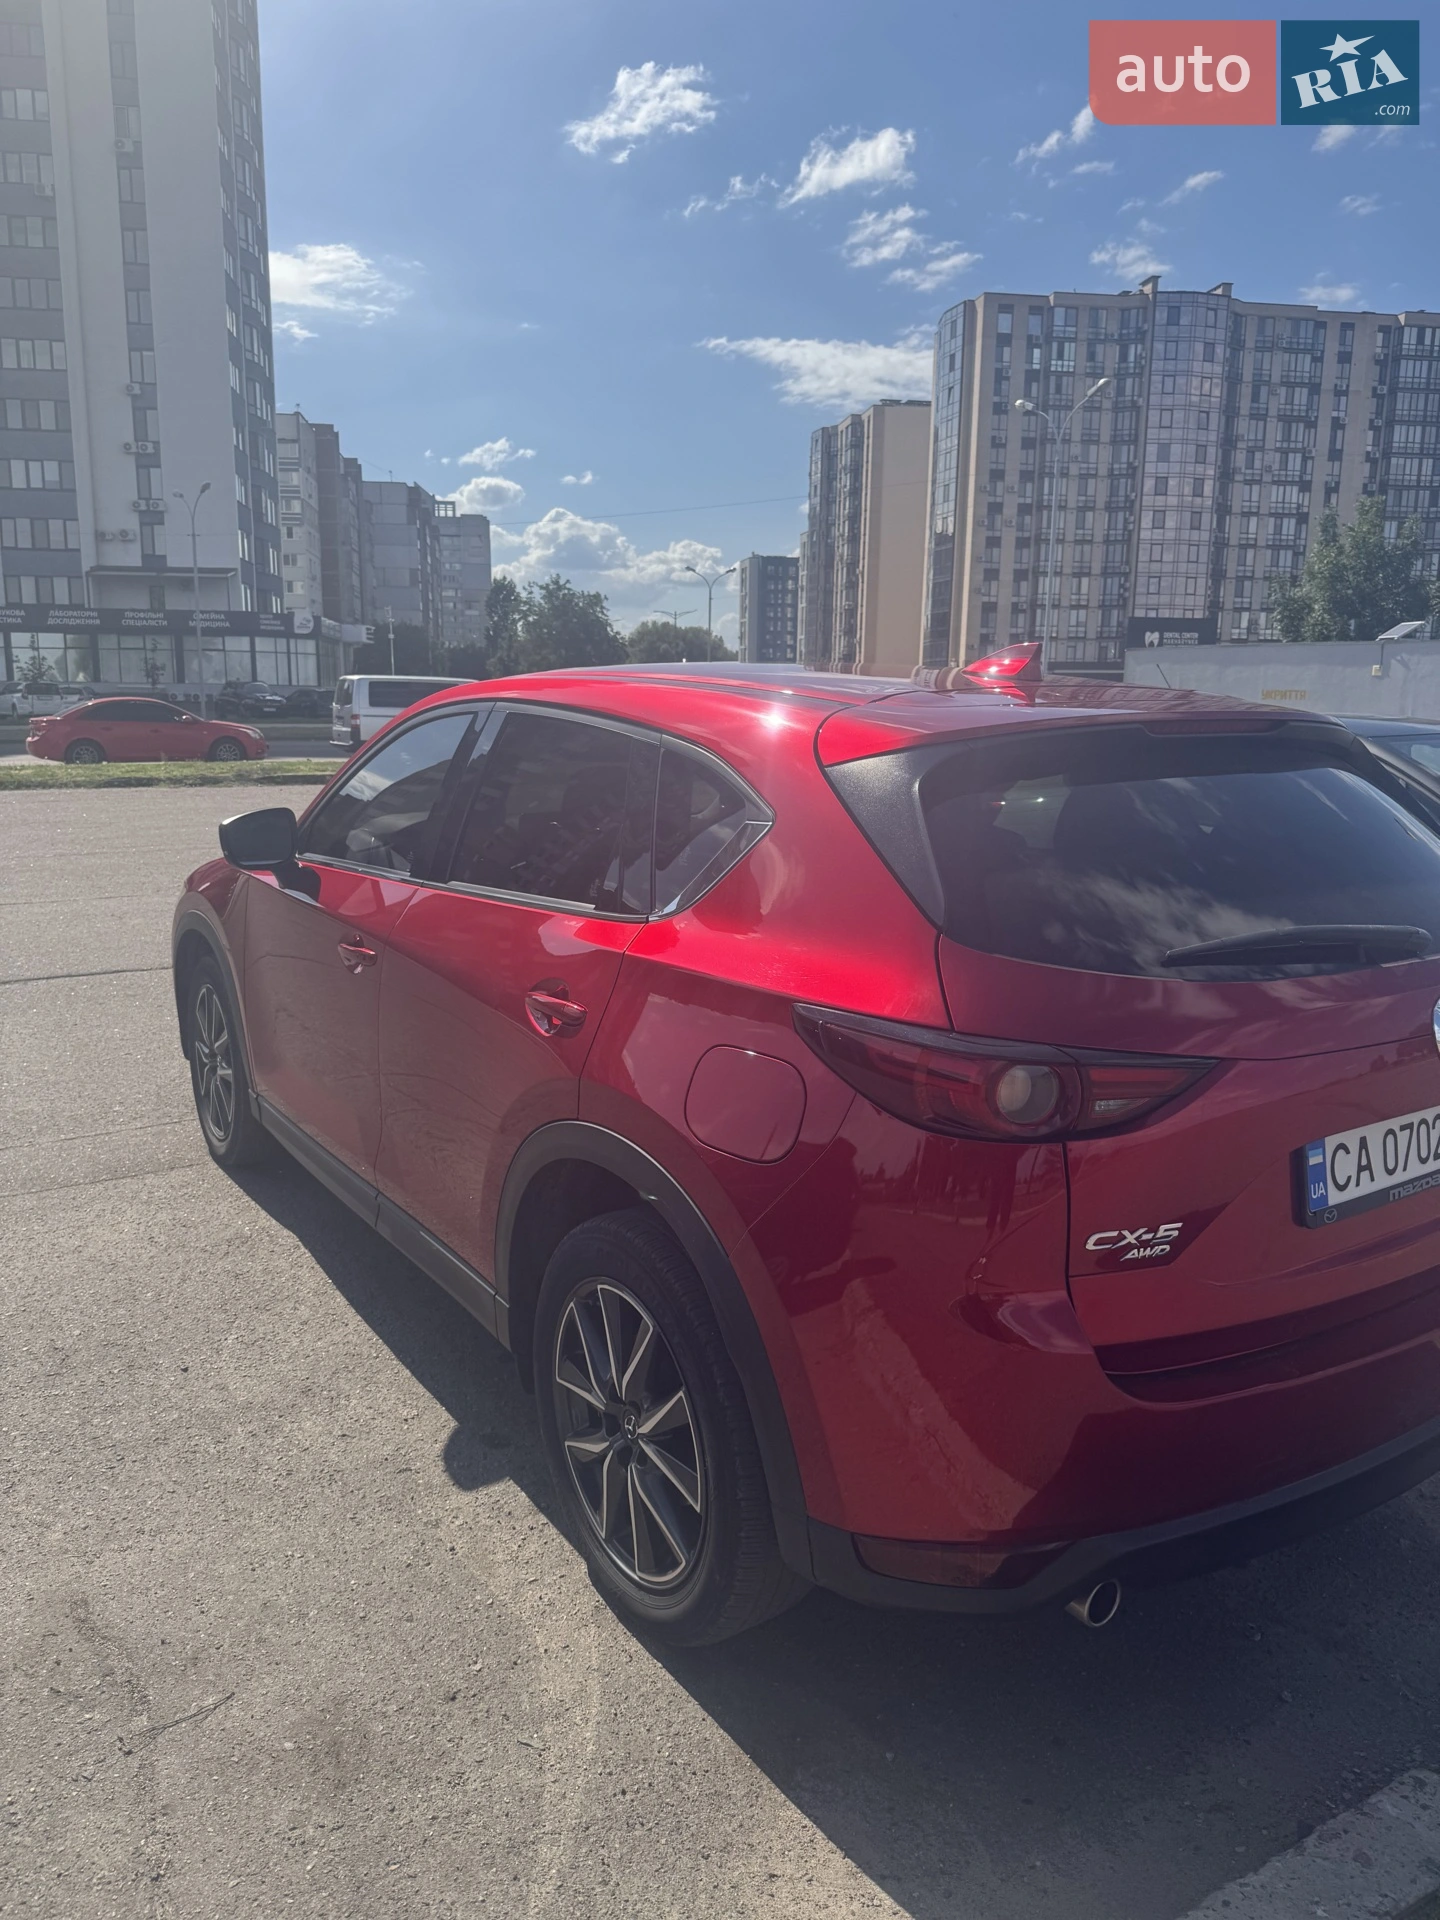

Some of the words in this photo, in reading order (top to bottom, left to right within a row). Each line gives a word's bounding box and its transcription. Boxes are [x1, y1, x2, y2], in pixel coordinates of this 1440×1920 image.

[124, 611, 164, 619] ПРОФІЛЬНІ
[193, 612, 226, 620] СМЕЙНА
[121, 618, 168, 626] СПЕЦІАЛІСТИ
[188, 620, 231, 628] МДИЦИНА
[1261, 688, 1305, 700] УКРИТТЯ
[1330, 1136, 1375, 1192] CA
[1311, 1181, 1326, 1199] UA
[1085, 1222, 1183, 1250] CX-5
[1120, 1245, 1170, 1261] AWD
